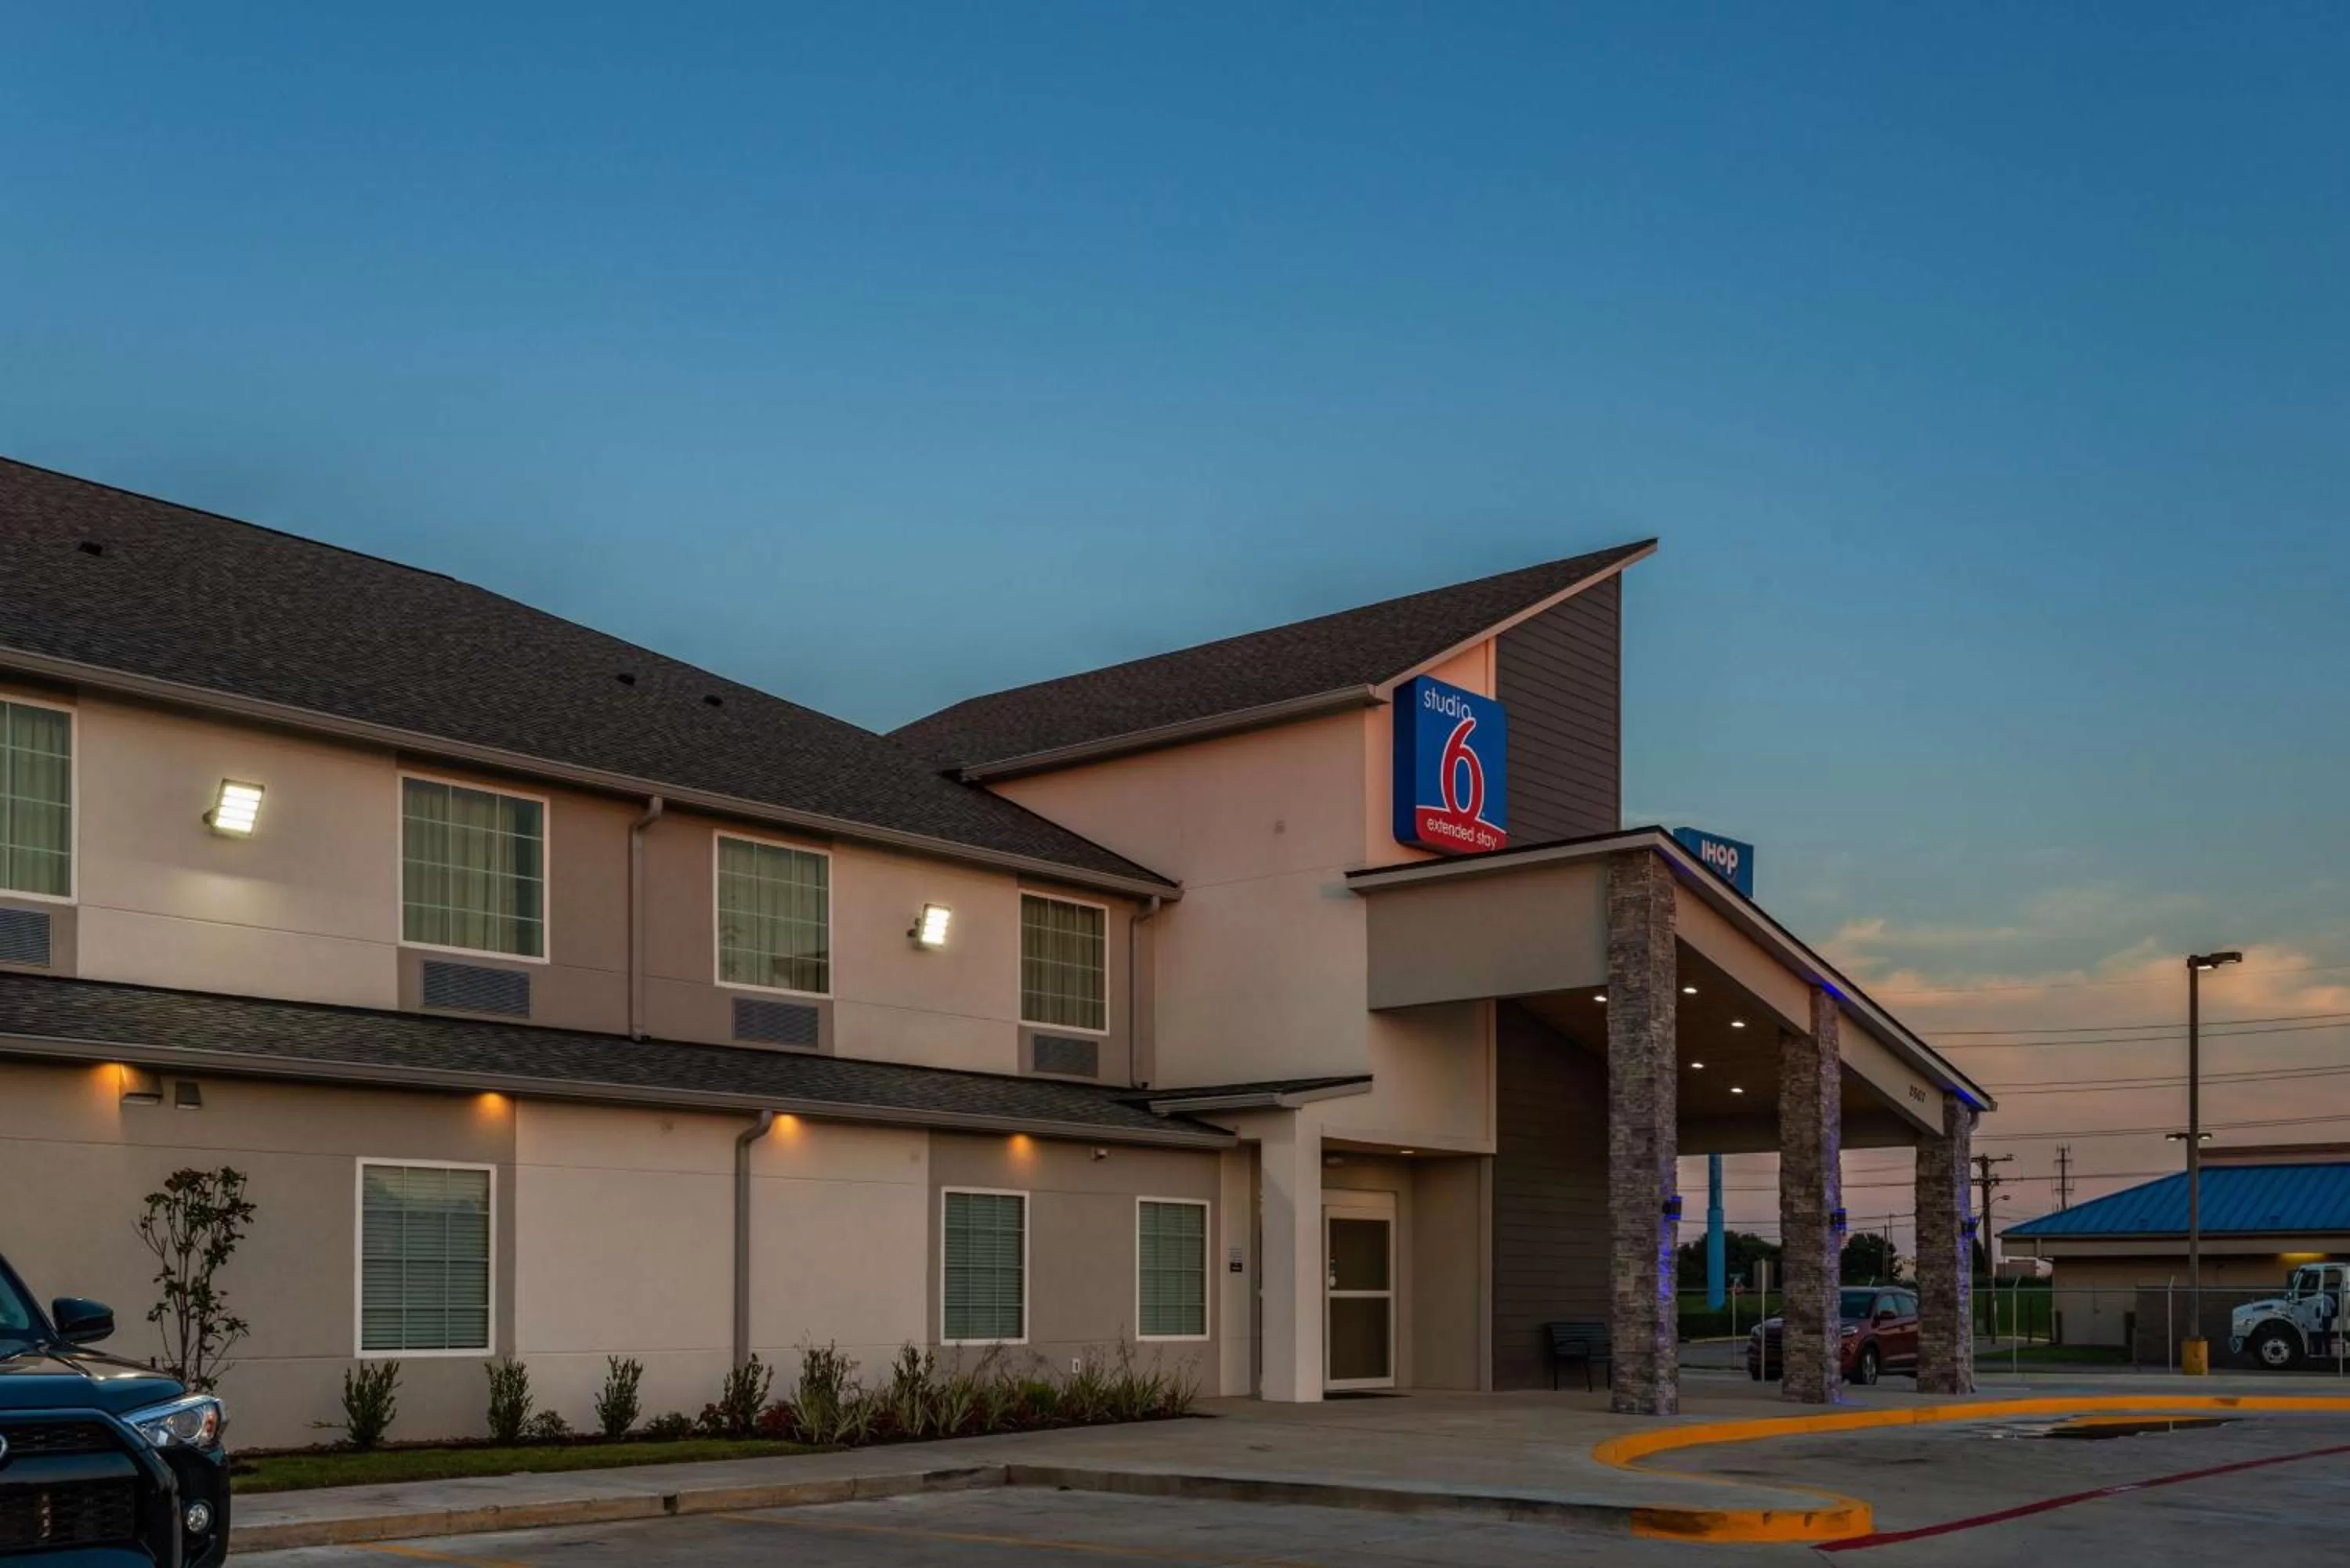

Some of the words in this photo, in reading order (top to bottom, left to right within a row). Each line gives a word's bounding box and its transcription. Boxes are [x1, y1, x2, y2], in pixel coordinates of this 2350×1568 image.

[1424, 687, 1471, 719] studio
[1441, 716, 1484, 820] 6
[1426, 818, 1475, 843] extended
[1476, 829, 1497, 851] stay
[1701, 839, 1738, 875] IHOP
